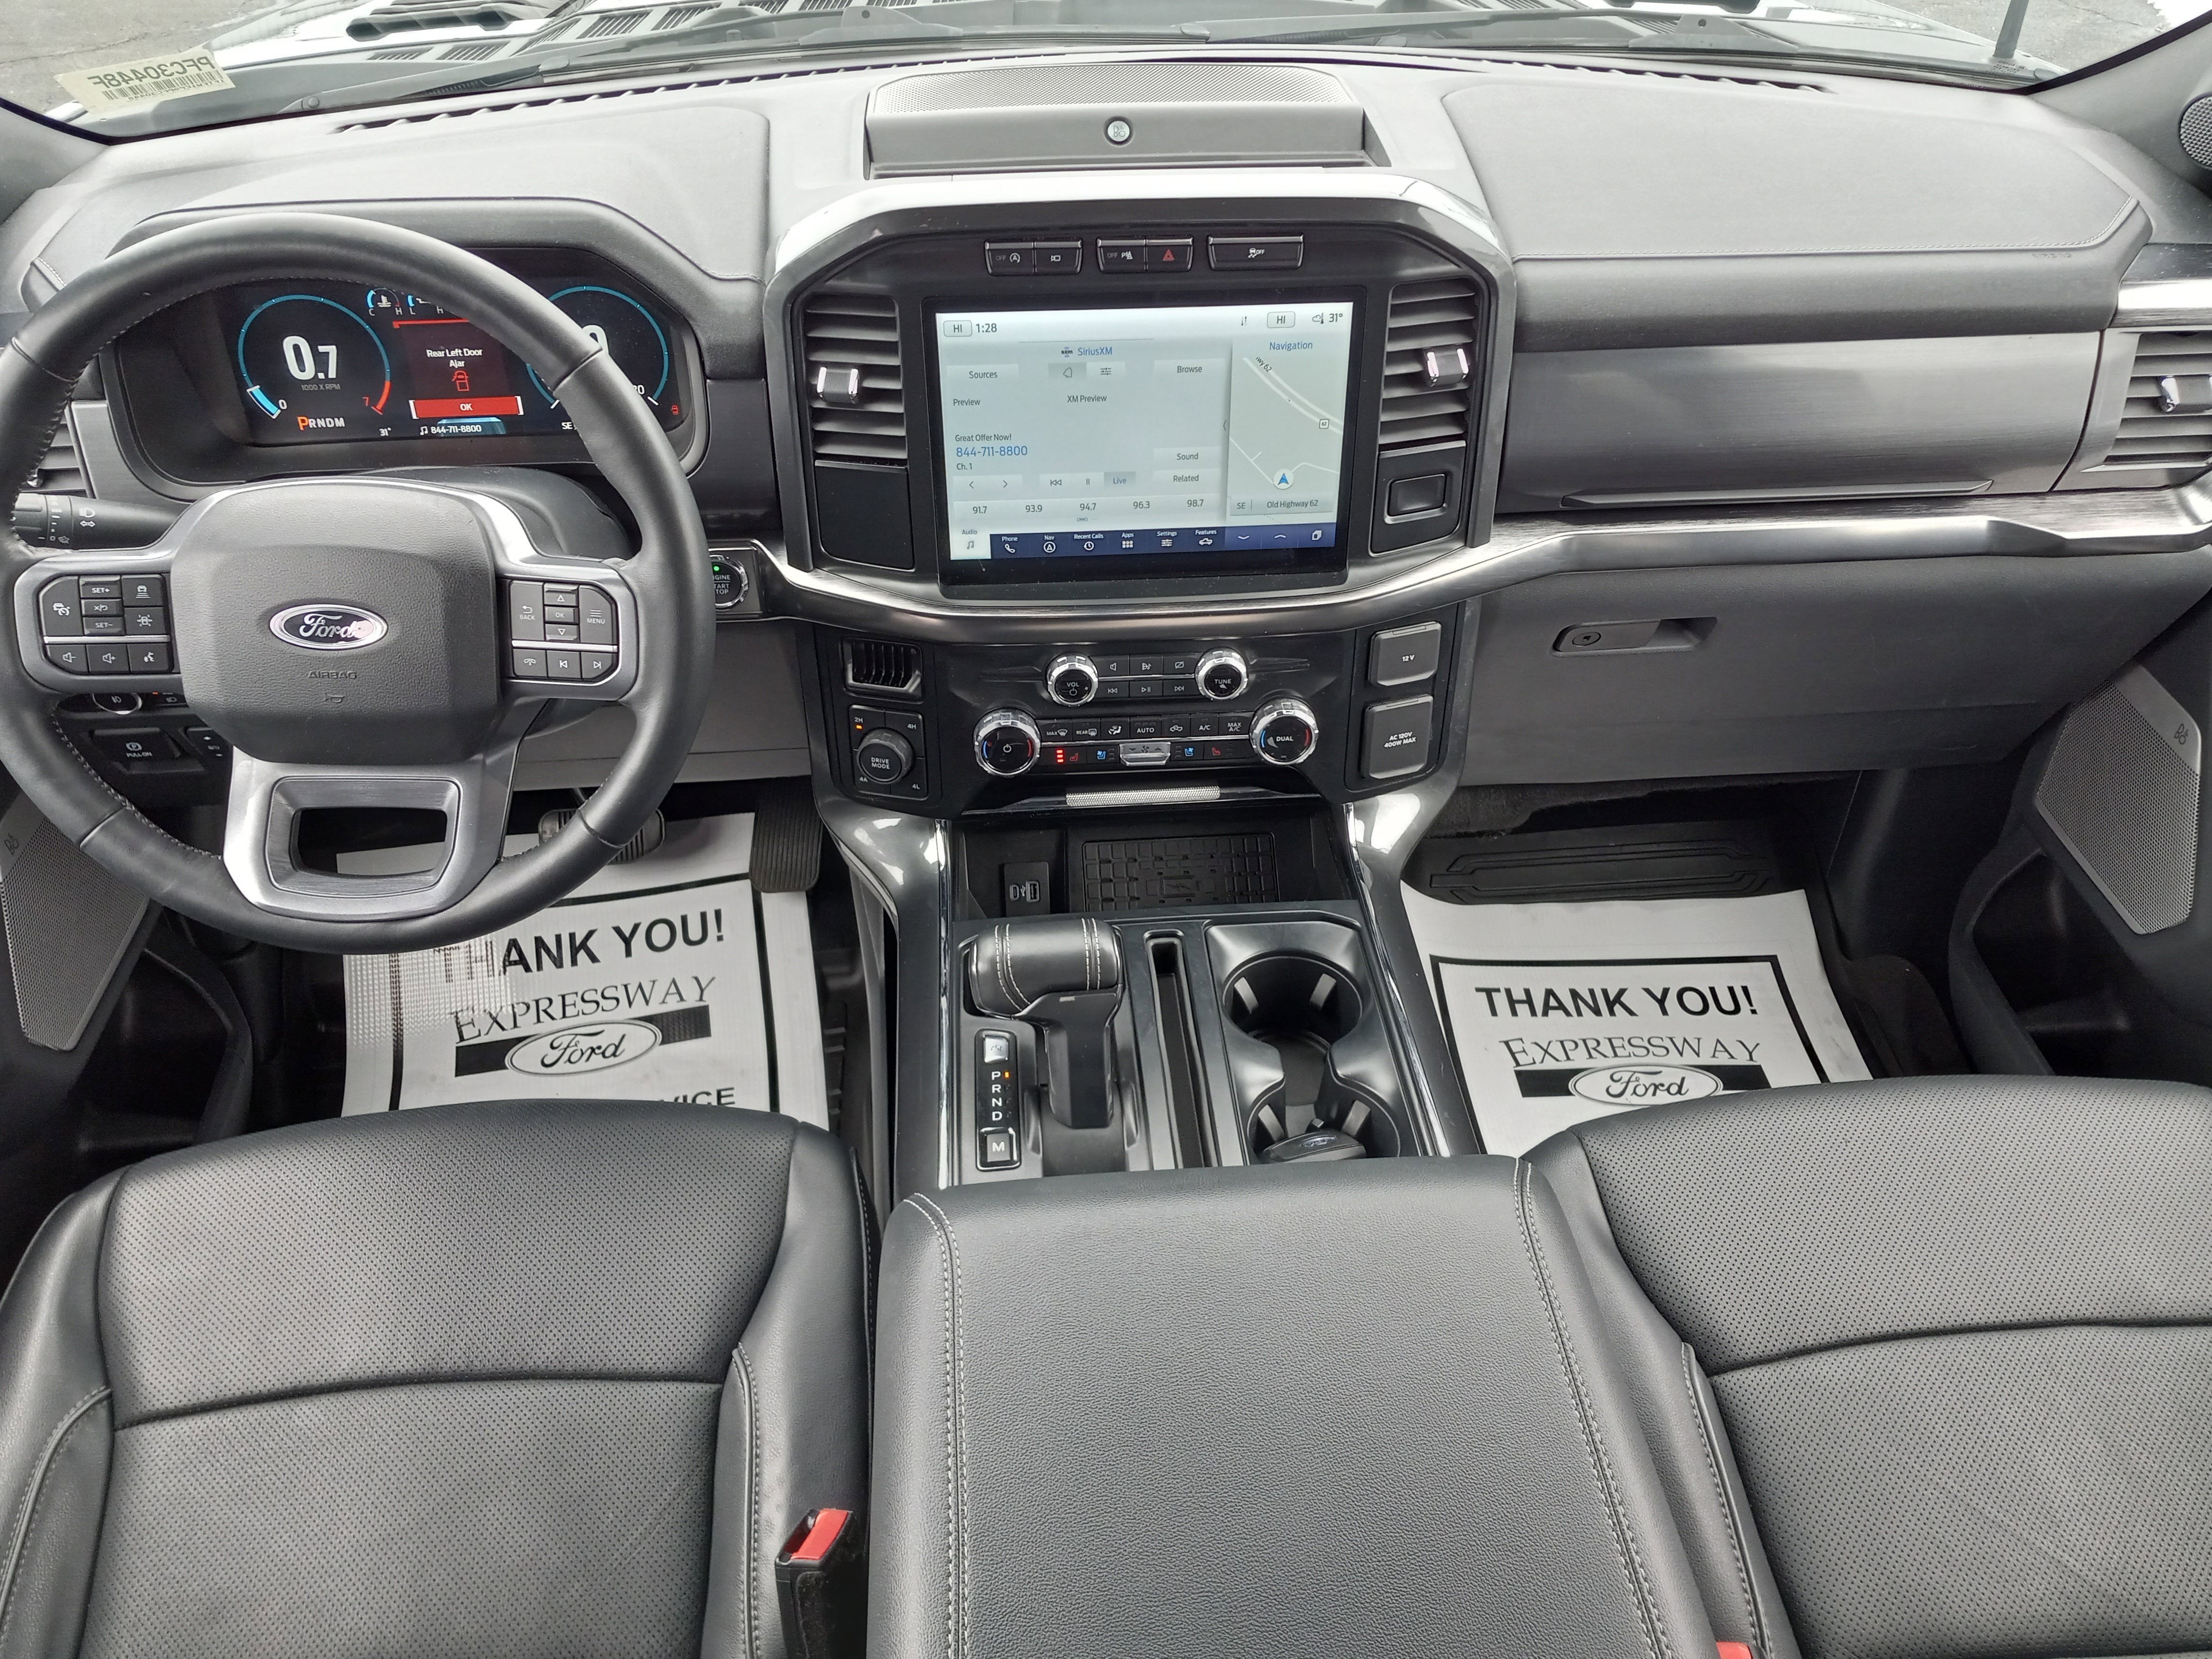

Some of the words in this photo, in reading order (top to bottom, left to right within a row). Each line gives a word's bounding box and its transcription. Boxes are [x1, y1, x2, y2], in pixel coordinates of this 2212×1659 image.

[1277, 315, 1285, 324] HI
[953, 325, 962, 333] HI
[976, 323, 997, 333] 1:28
[1269, 341, 1313, 351] Navigation
[1078, 347, 1112, 356] SiriusXM
[283, 336, 337, 380] 0.7
[1263, 364, 1272, 373] 62
[279, 399, 287, 409] 0
[460, 403, 473, 411] OK
[431, 424, 481, 434] 844-711-8800
[956, 445, 1028, 457] 844-711-8800
[1133, 501, 1150, 509] 96.3
[1280, 500, 1309, 509] Highway
[299, 613, 358, 638] Ford
[307, 671, 357, 679] AIRBAG
[1398, 731, 1413, 739] 120V
[1383, 740, 1403, 748] 400W
[1403, 736, 1417, 744] MAX
[433, 927, 601, 984] THANK
[612, 908, 724, 959] YOU!
[1475, 986, 1639, 1018] THANK
[1642, 985, 1759, 1016] YOU!
[449, 976, 716, 1045] EXPRESSWAY
[540, 1029, 626, 1068] Ford
[1499, 1036, 1761, 1069] EXPRESSWAY
[991, 1071, 1001, 1081] P
[992, 1084, 1002, 1094] R
[1606, 1070, 1689, 1098] Ford
[992, 1097, 1002, 1107] N
[992, 1111, 1003, 1121] D
[992, 1142, 1005, 1152] M
